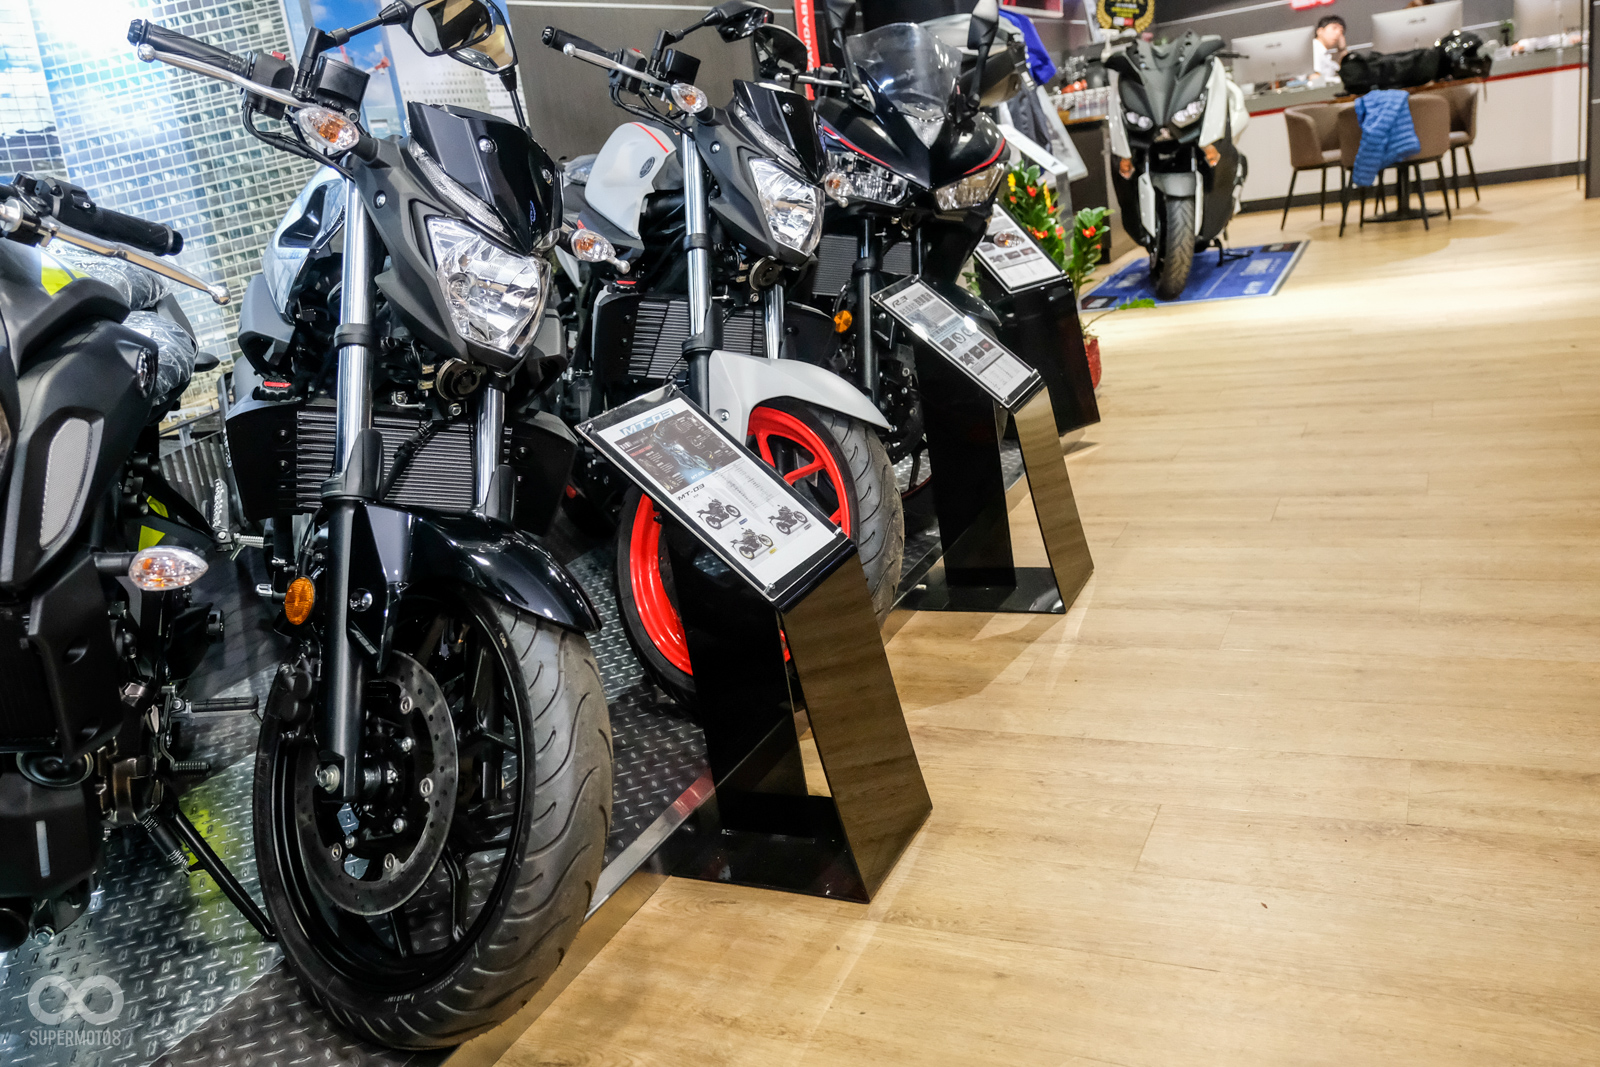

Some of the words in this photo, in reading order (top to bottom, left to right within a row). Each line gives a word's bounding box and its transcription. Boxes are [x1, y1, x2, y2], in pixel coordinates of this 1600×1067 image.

[800, 0, 815, 72] PANDAB
[621, 408, 675, 436] MT-03
[677, 483, 705, 501] MT-03
